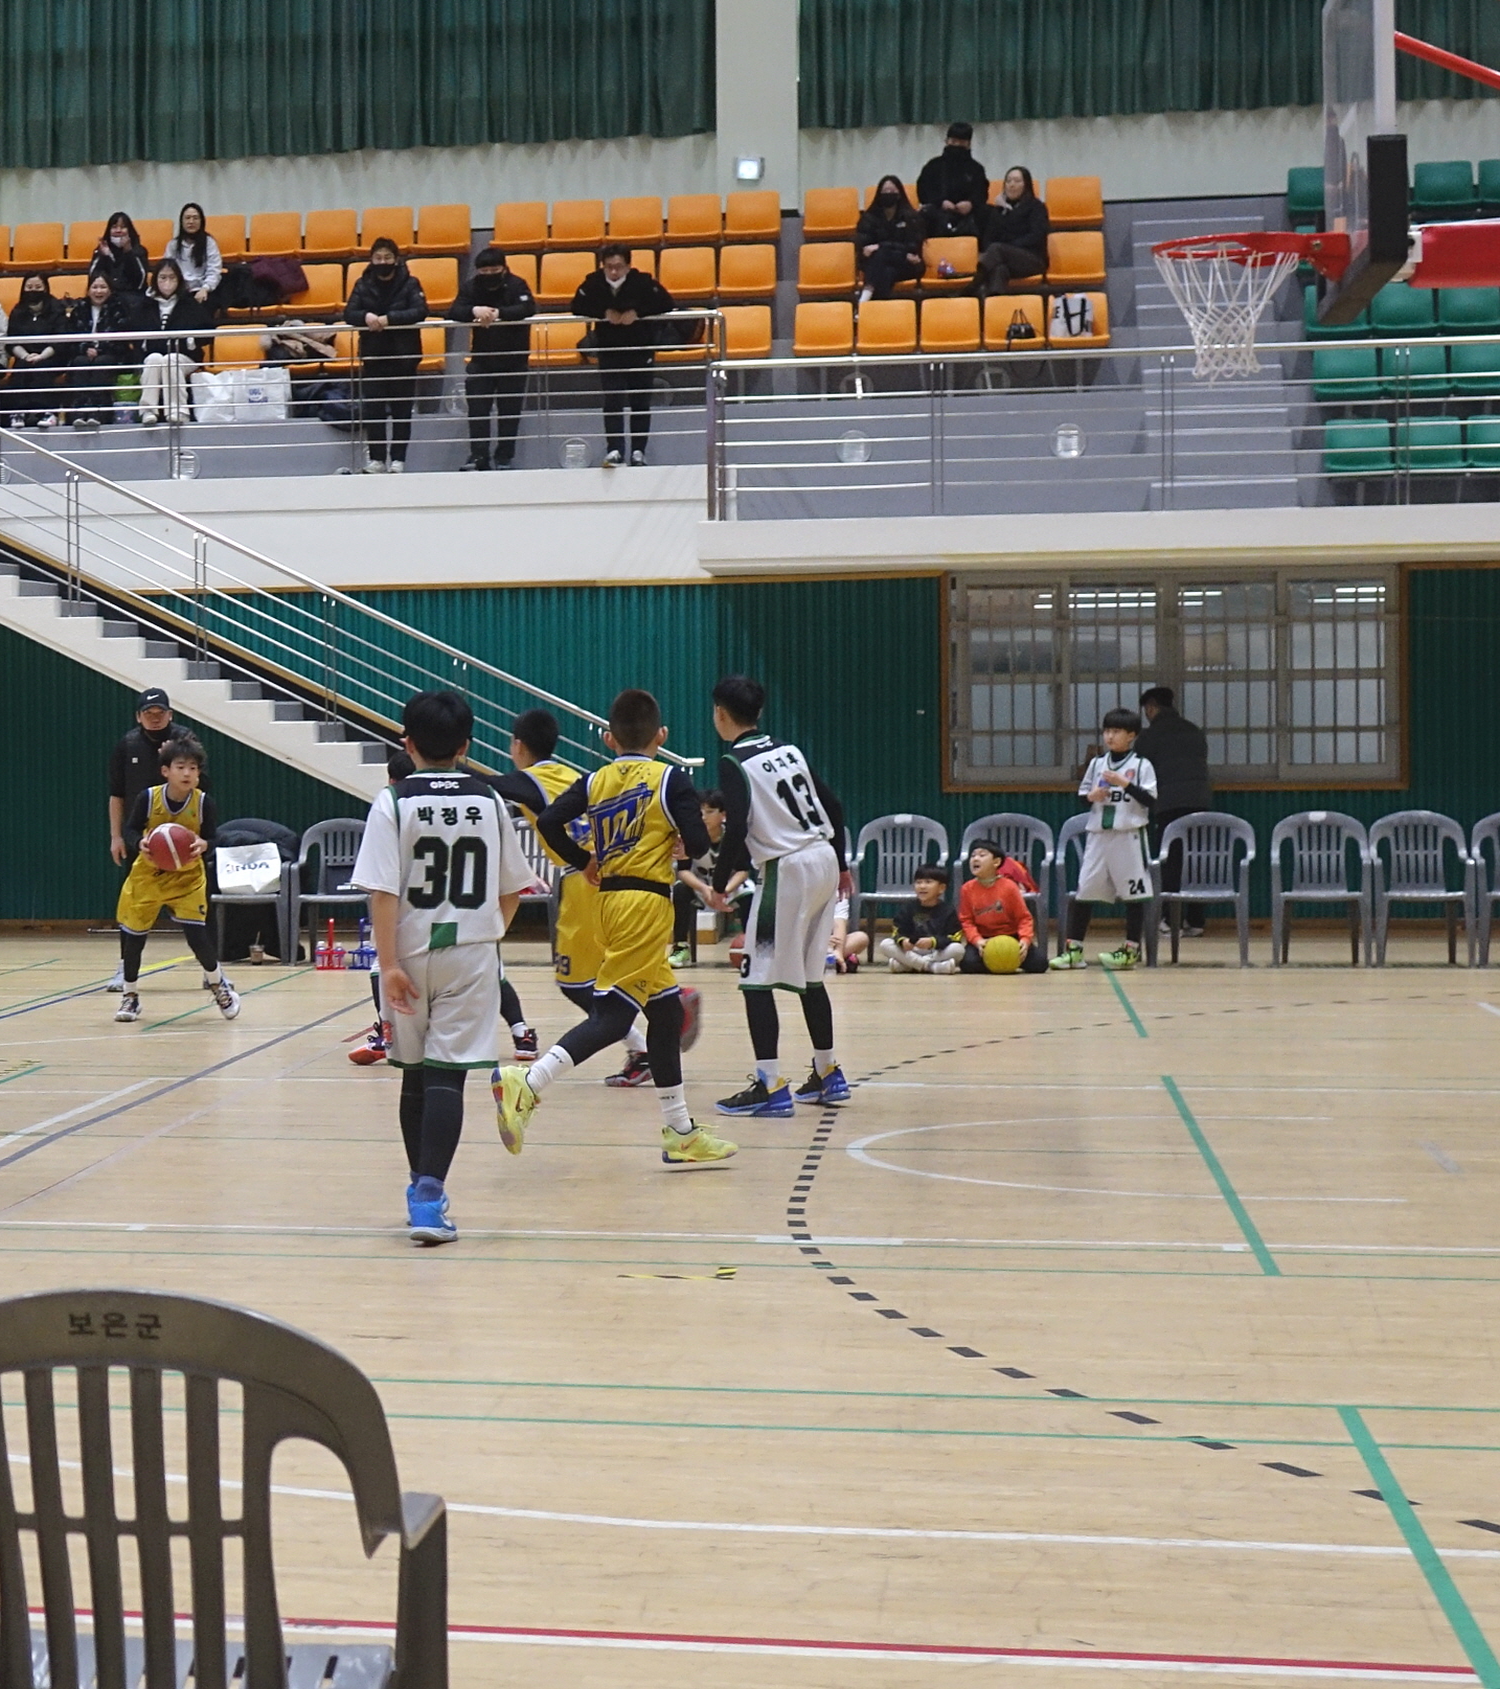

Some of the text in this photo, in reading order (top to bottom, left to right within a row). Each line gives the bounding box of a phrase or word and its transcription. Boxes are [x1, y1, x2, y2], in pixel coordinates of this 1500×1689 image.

[417, 806, 483, 826] 박정우
[776, 772, 825, 832] 13
[407, 836, 488, 910] 30
[1128, 878, 1146, 895] 24
[68, 1312, 162, 1340] 보은군
